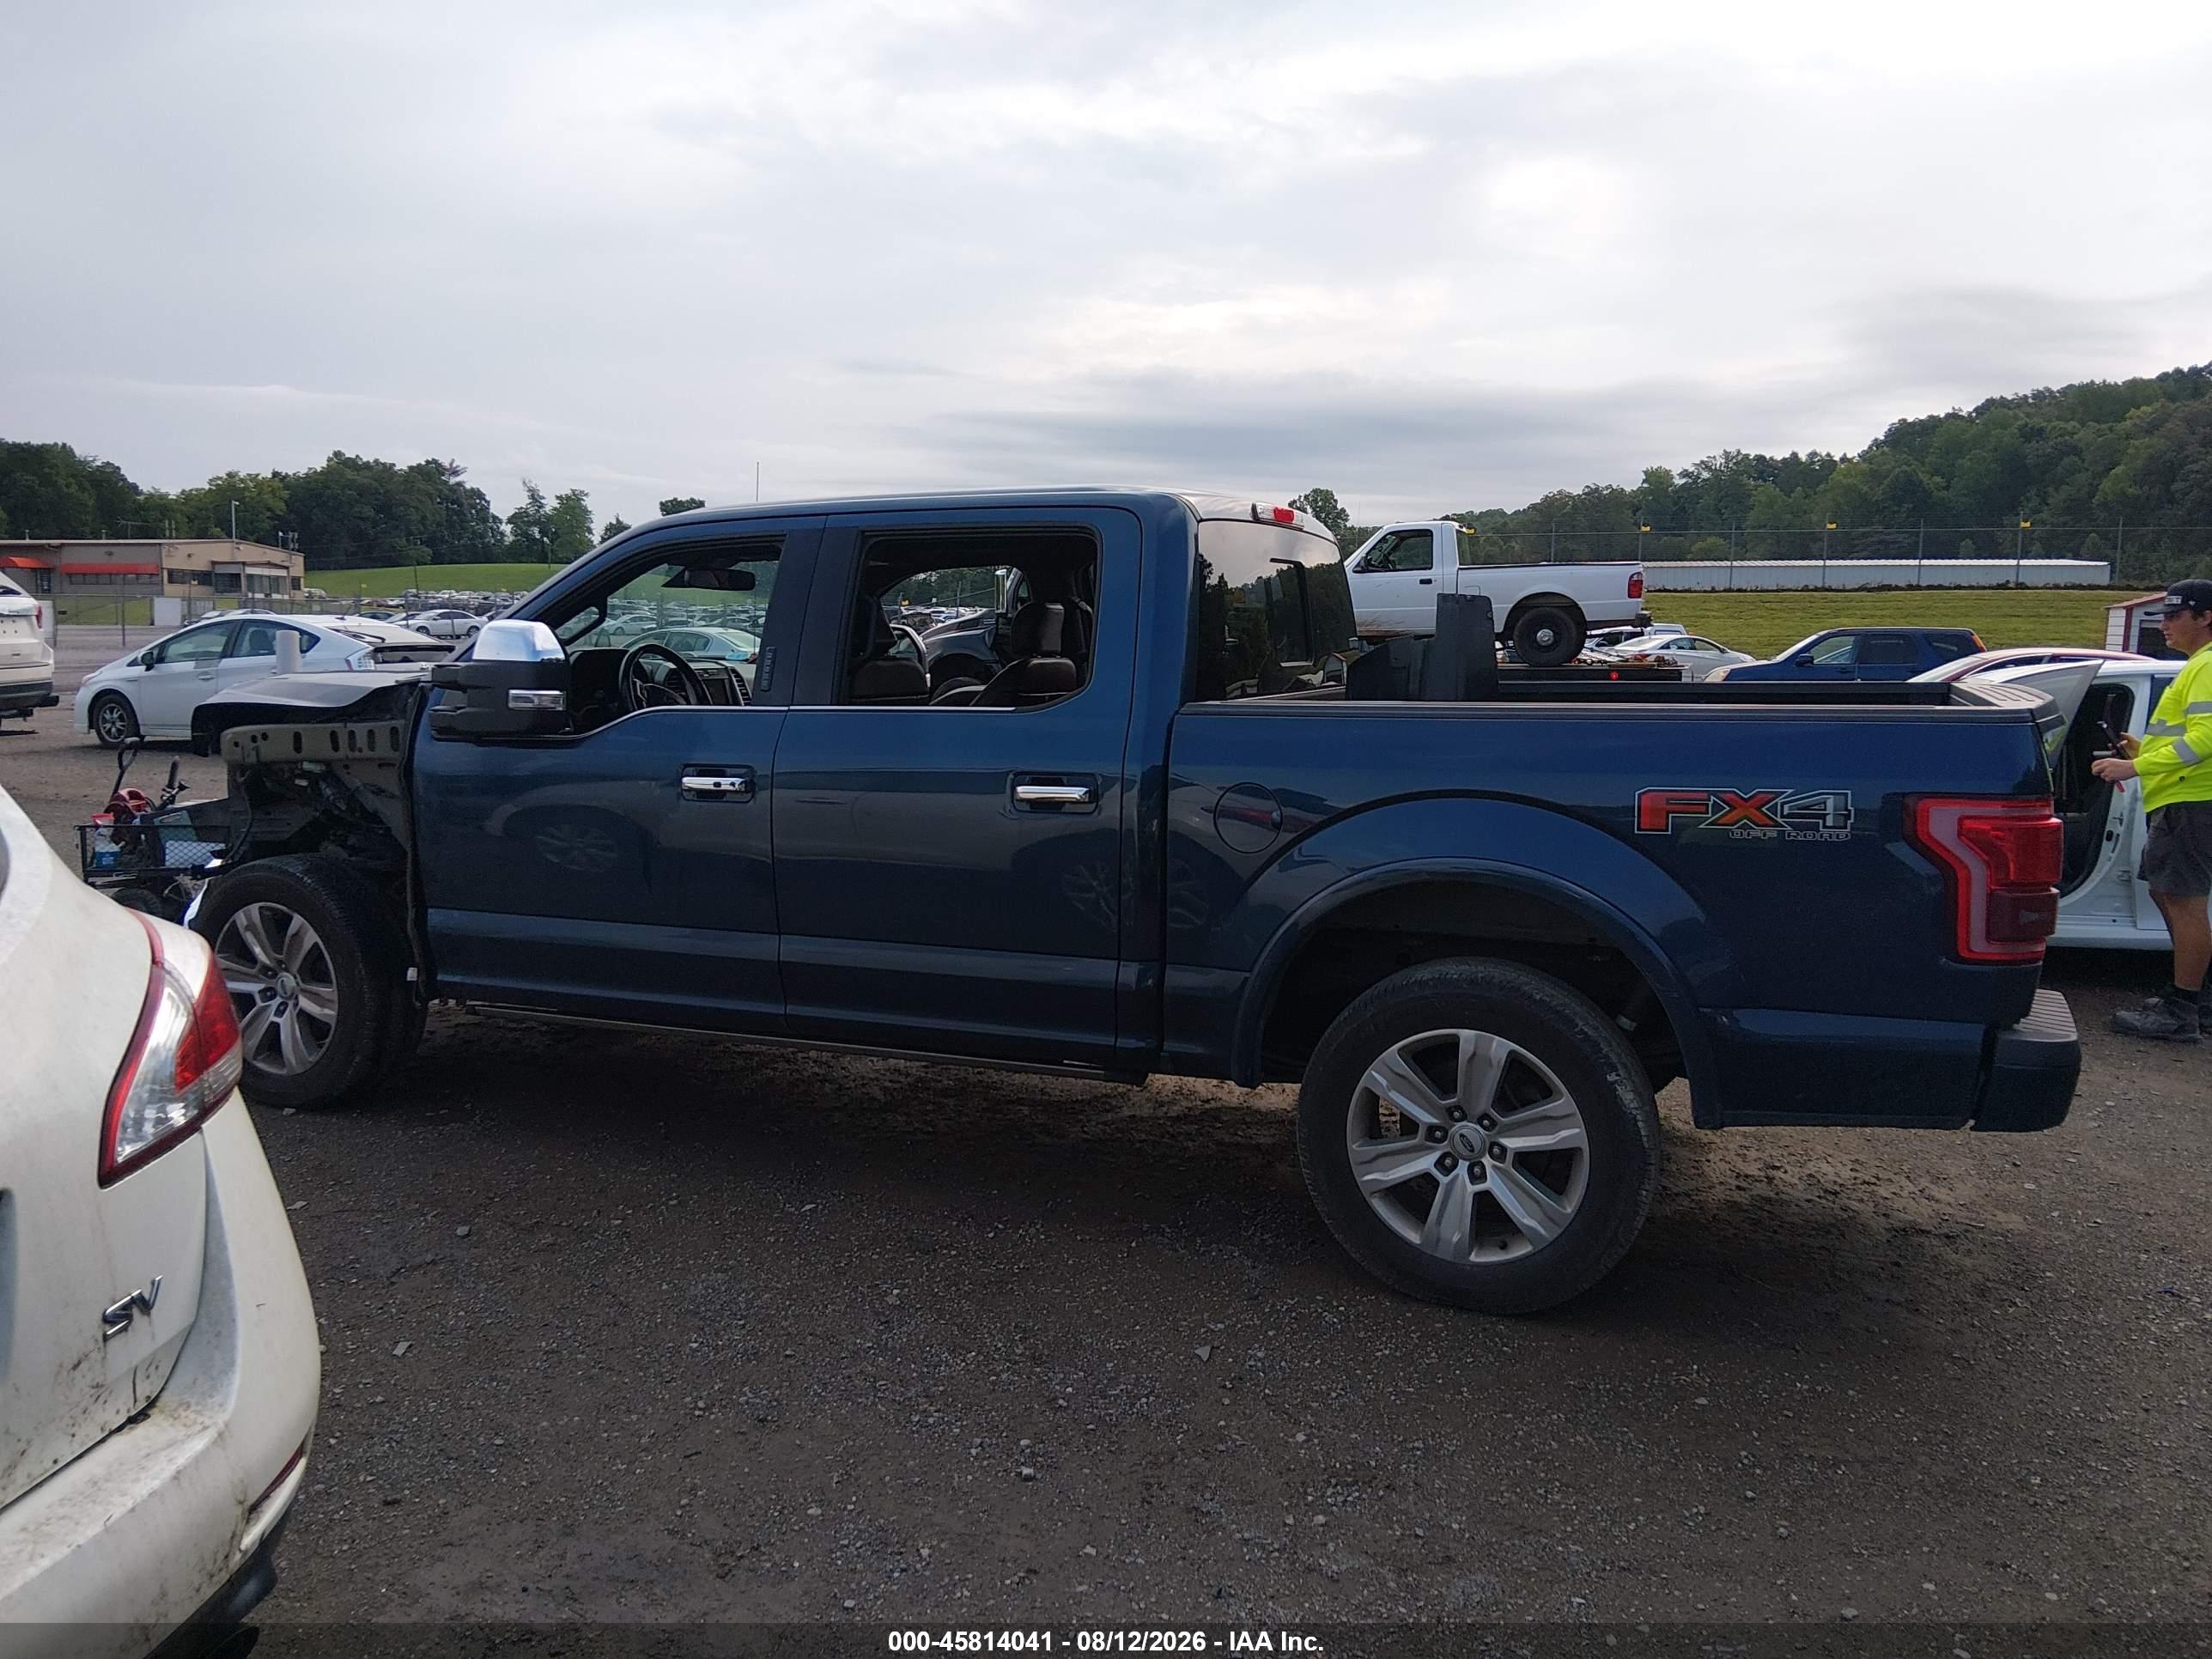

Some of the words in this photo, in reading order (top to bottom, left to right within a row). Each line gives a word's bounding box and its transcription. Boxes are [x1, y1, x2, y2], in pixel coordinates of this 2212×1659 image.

[1635, 787, 1854, 834] FX4
[1729, 830, 1778, 840] OFF
[1785, 830, 1851, 842] ROAD
[102, 1275, 163, 1341] SV
